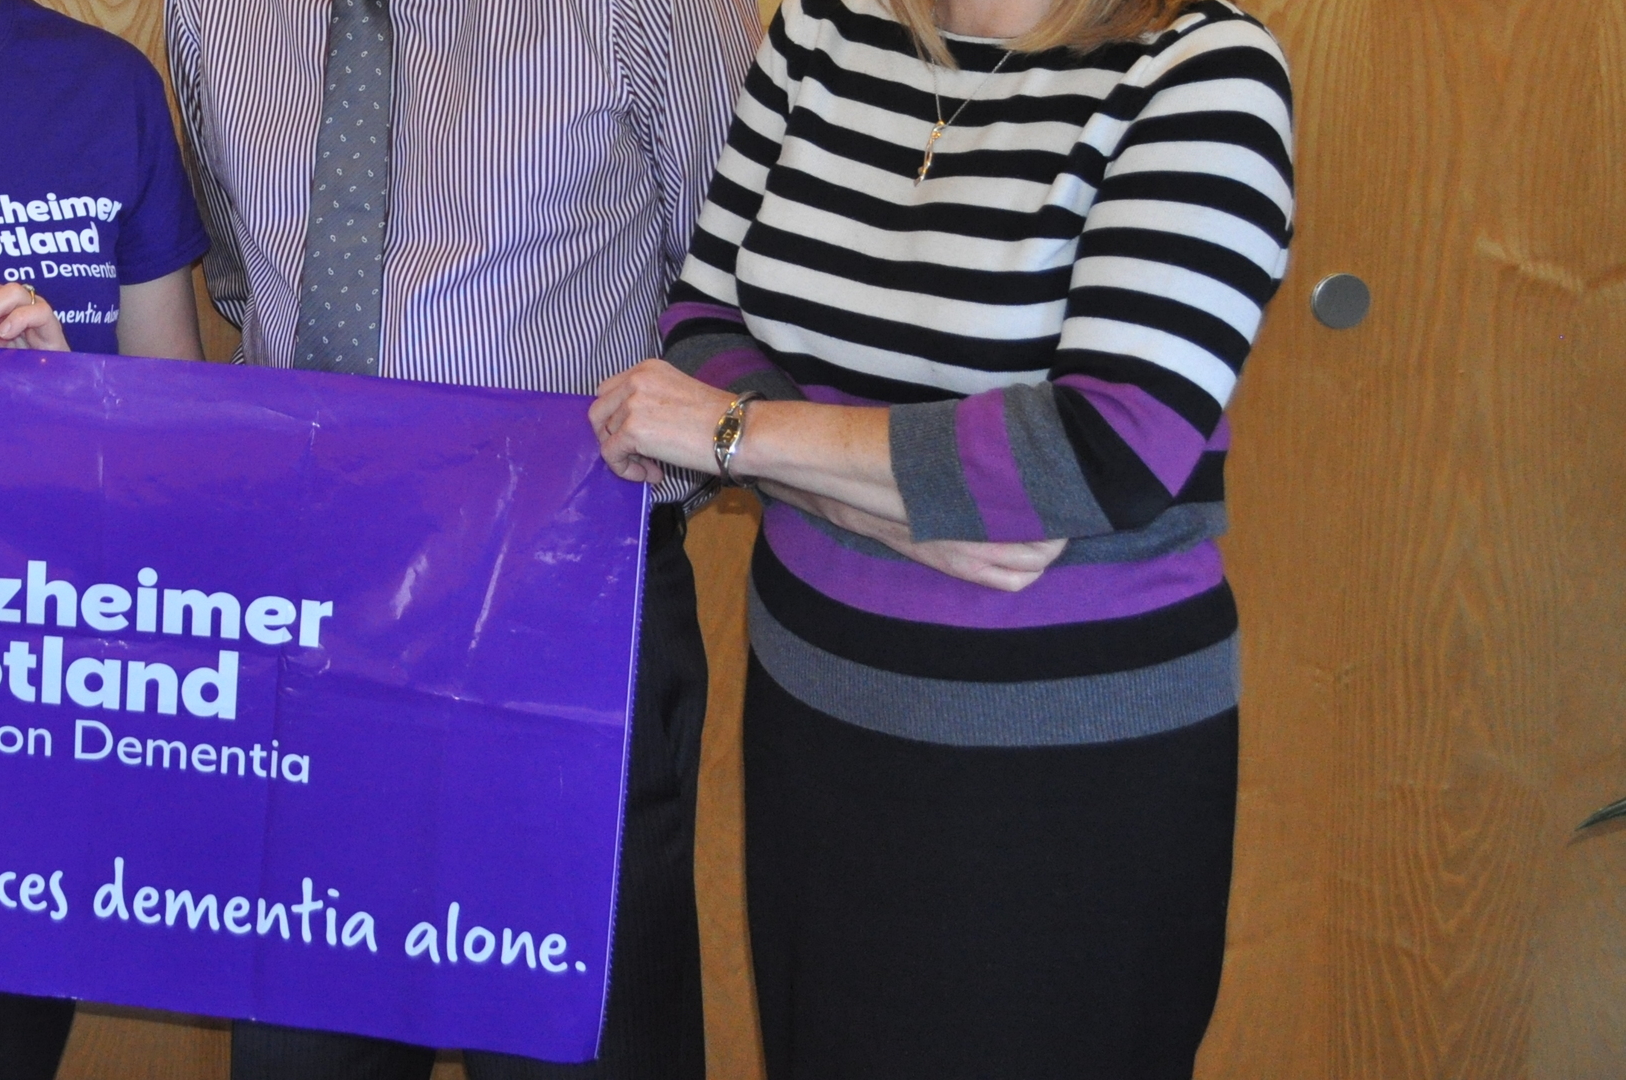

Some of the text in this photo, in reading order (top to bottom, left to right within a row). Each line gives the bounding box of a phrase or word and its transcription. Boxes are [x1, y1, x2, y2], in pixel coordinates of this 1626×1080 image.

[3, 266, 36, 282] on
[74, 720, 310, 784] Dementia
[93, 856, 378, 953] dementia
[404, 901, 588, 973] alone.
